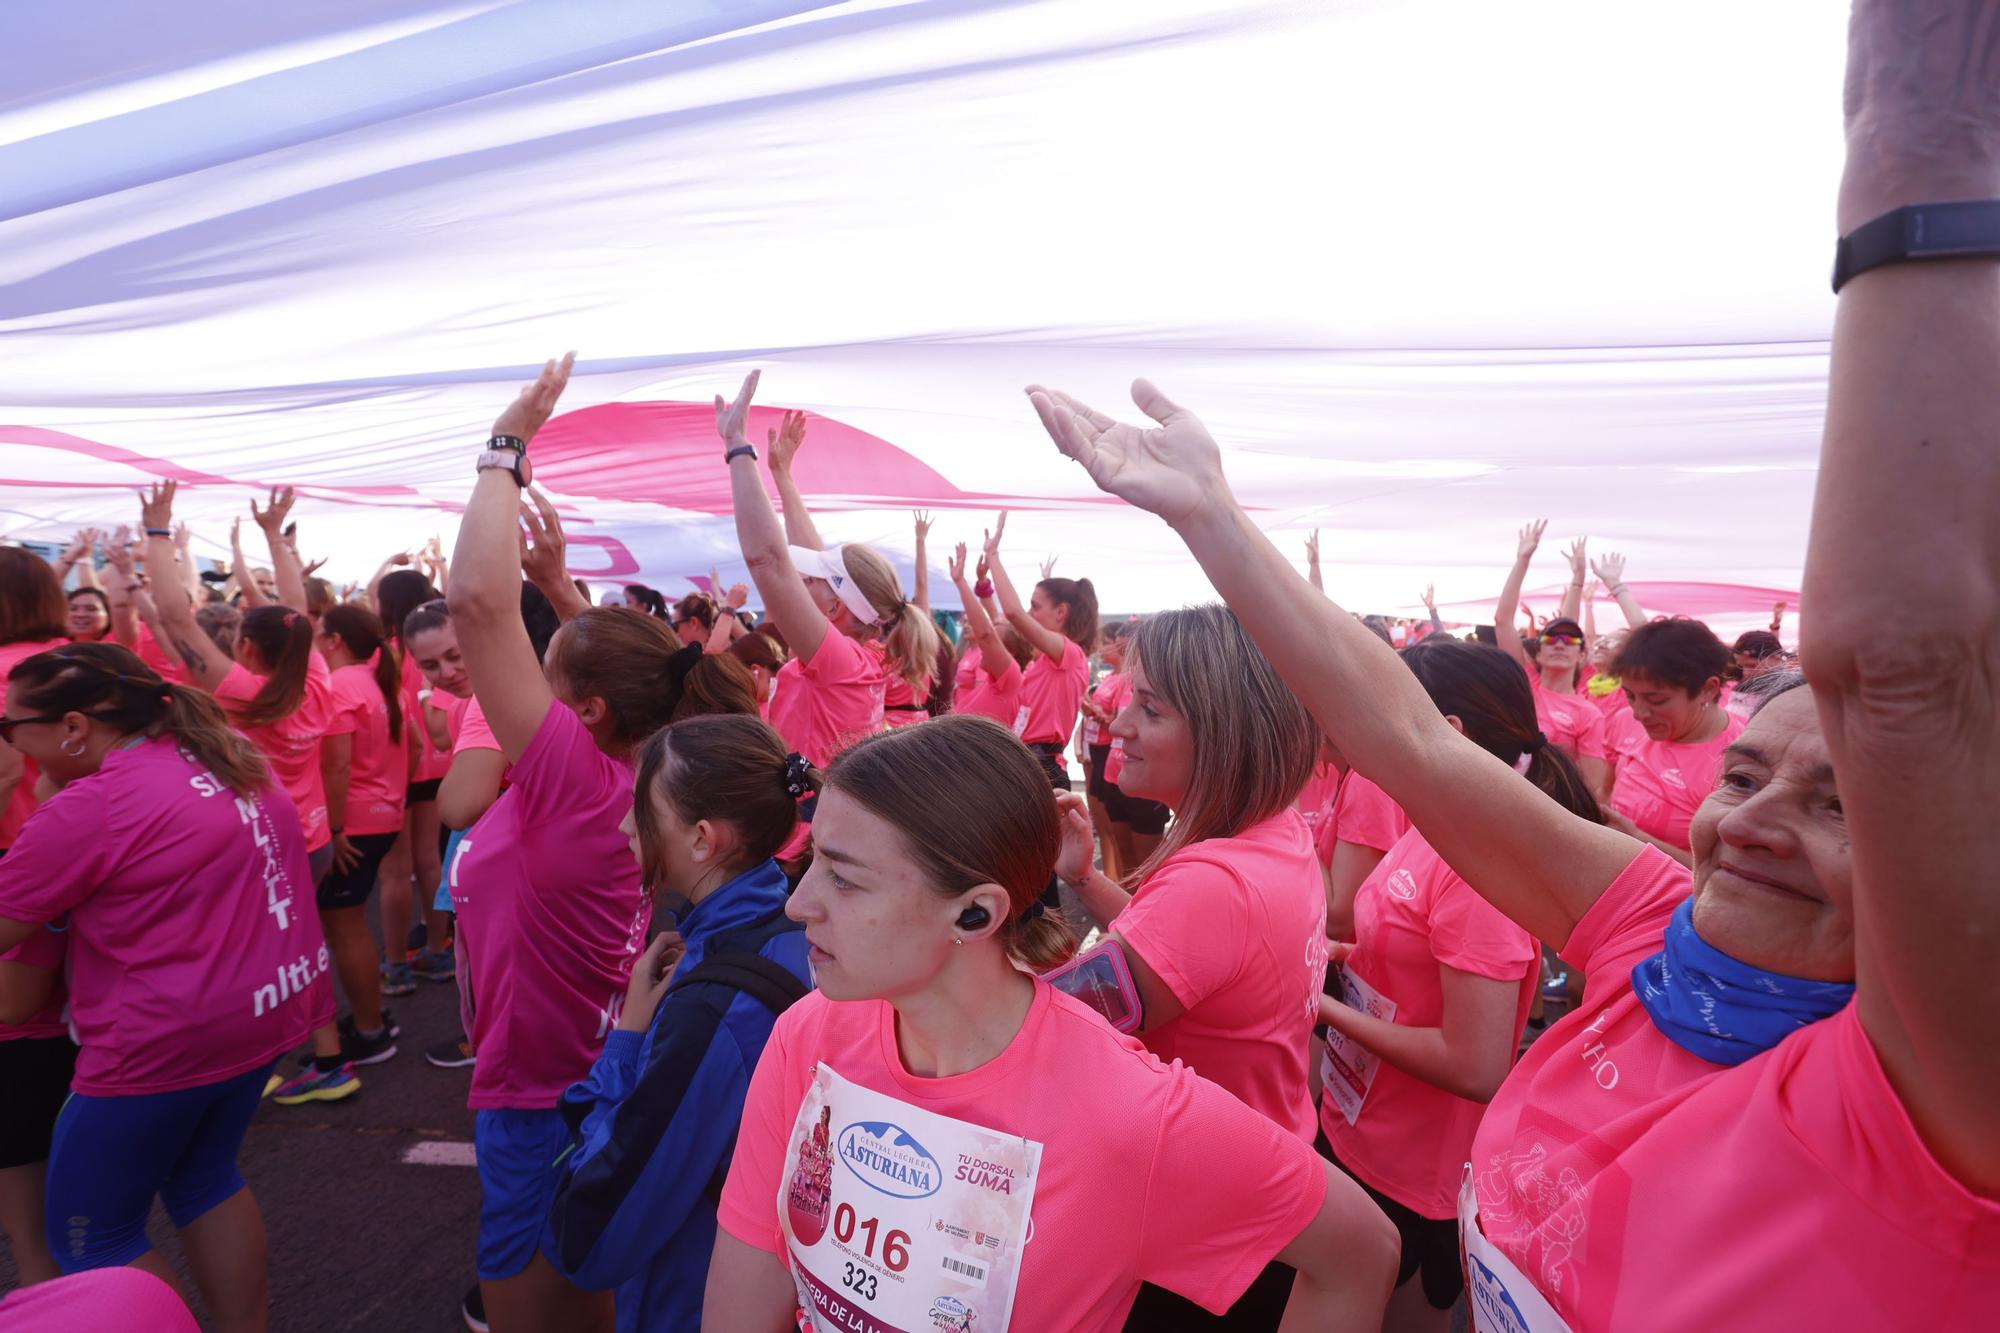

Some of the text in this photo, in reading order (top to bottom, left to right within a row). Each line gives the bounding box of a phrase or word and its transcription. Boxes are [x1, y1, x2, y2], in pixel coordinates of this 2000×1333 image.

[843, 1133, 931, 1191] ASTURIANA
[860, 1136, 931, 1170] CENTRAL LECHERA
[958, 1153, 1015, 1179] TU DORSAL
[954, 1165, 1010, 1195] SUMA
[833, 1202, 912, 1272] 016
[842, 1261, 878, 1301] 323
[829, 1301, 848, 1323] DE
[847, 1313, 864, 1333] LA
